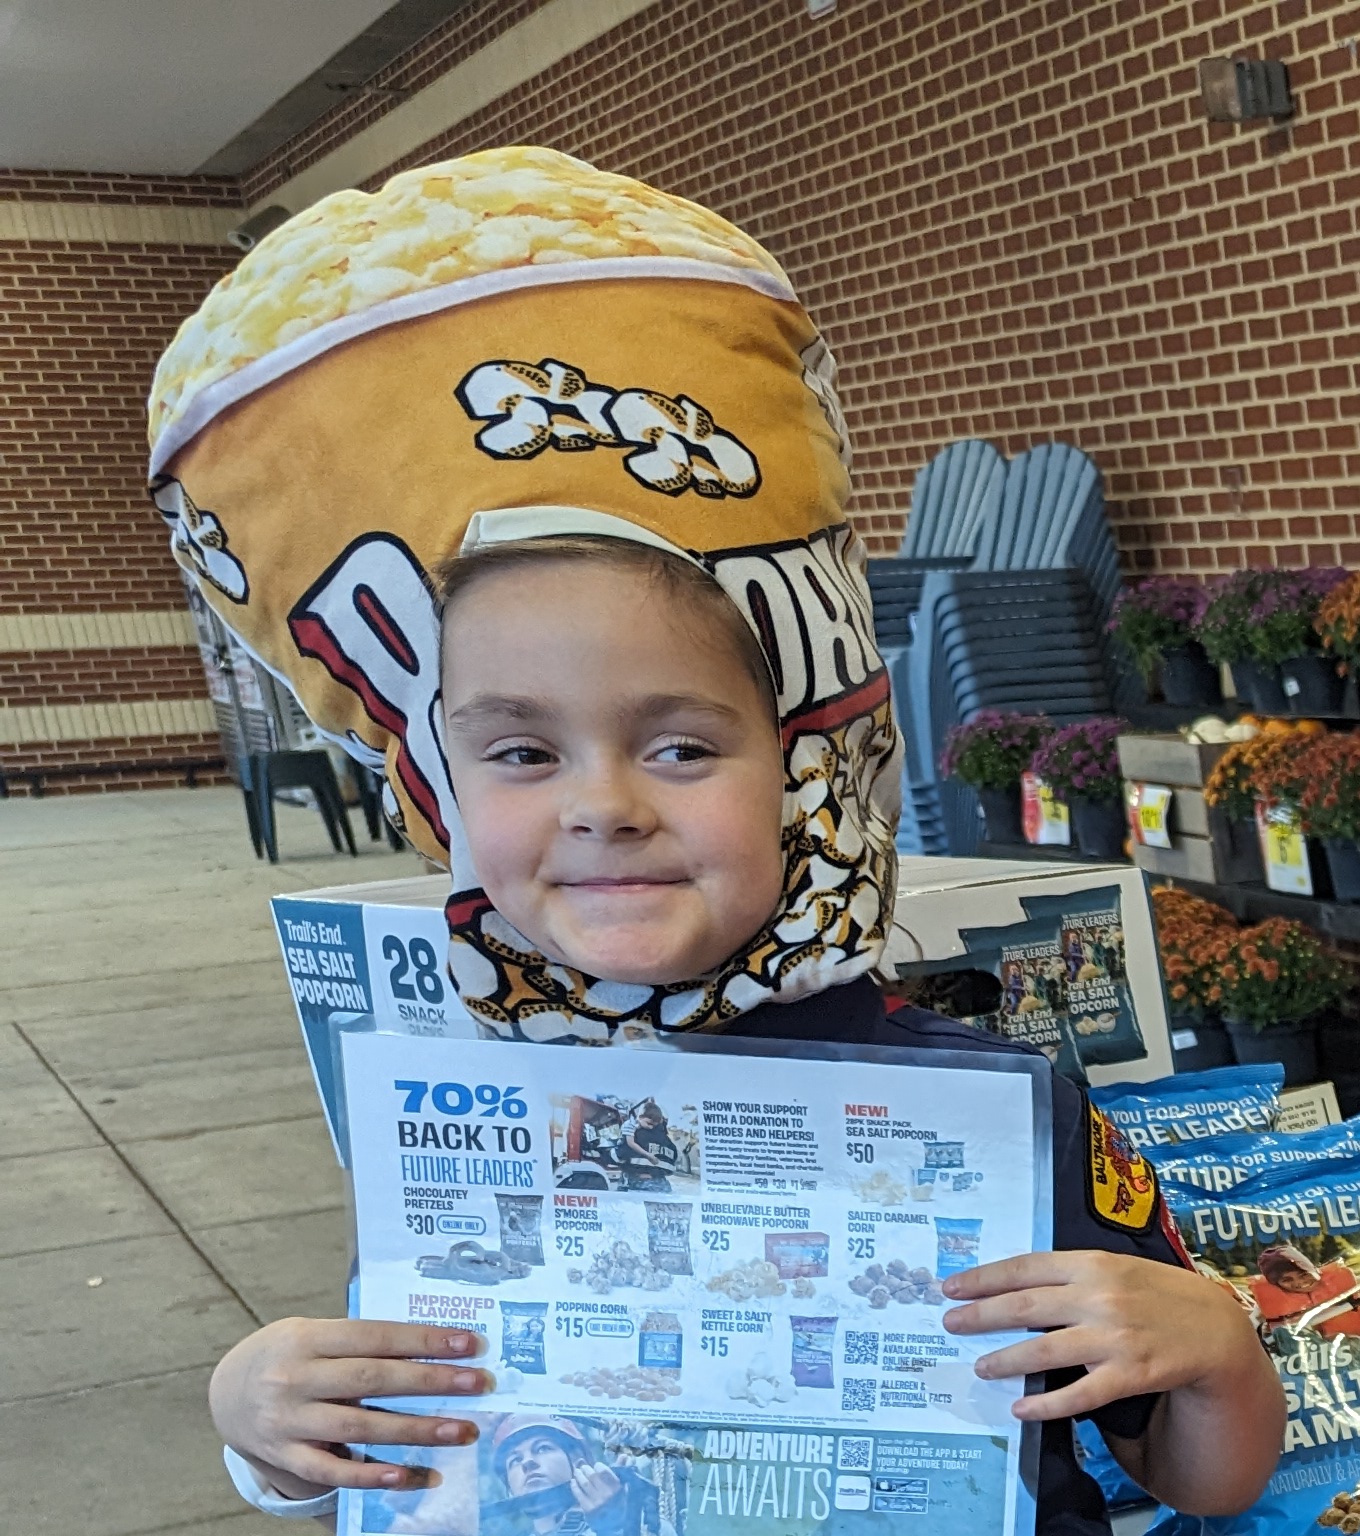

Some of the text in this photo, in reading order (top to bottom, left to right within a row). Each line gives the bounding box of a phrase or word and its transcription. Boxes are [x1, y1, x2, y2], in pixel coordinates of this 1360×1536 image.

[284, 919, 342, 945] Trail's End
[288, 947, 356, 979] SEA SALT
[382, 935, 445, 1005] 28
[292, 977, 368, 1011] POPCORN
[398, 1003, 448, 1025] SNACK
[394, 1080, 528, 1119] 70%
[703, 1101, 808, 1116] SHOW YOUR SUPPORT
[703, 1113, 803, 1128] WITH A DONATION TO
[397, 1121, 531, 1154] BACK TO
[704, 1126, 815, 1142] HEROES AND HELPERS!
[846, 1127, 938, 1141] SEA SALT POPCORN
[846, 1143, 874, 1164] $50
[401, 1154, 460, 1184] FUTURE
[403, 1187, 469, 1200] CHOCOLATEY
[404, 1199, 454, 1211] PRETZELS
[701, 1203, 810, 1218] UNBELIEVABLE BUTTER
[406, 1214, 435, 1236] $30
[701, 1215, 809, 1229] MICROWAVE POPCORN
[848, 1211, 930, 1225] SALTED CARAMEL
[848, 1223, 875, 1234] CORN
[1194, 1199, 1321, 1245] FUTURE
[703, 1430, 835, 1465] ADVENTURE
[699, 1464, 831, 1521] AWAITS
